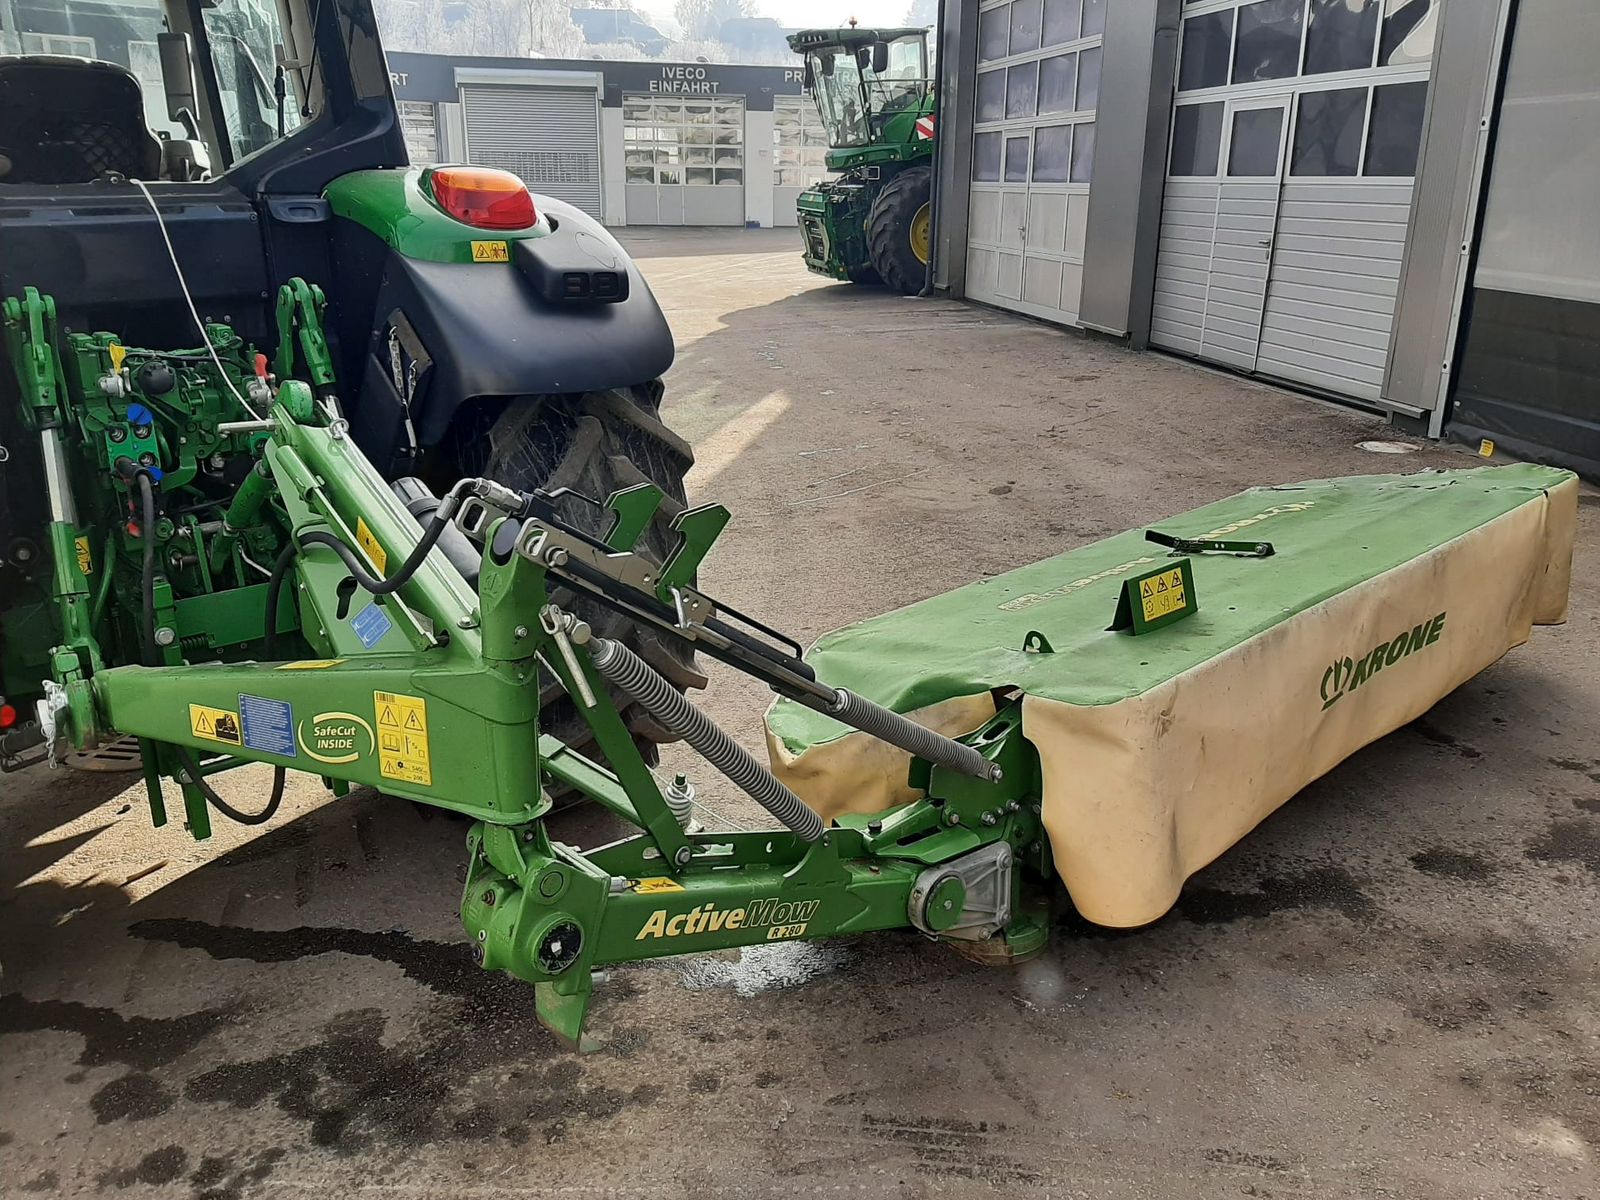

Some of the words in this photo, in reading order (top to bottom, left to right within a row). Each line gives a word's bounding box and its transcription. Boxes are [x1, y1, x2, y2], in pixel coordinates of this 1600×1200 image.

[662, 66, 706, 80] IVECO
[649, 80, 719, 94] EINFAHRT
[1348, 611, 1447, 692] KRONE
[313, 726, 357, 737] SafeCut
[317, 739, 353, 749] INSIDE
[635, 897, 820, 940] ActiveMow
[771, 927, 780, 938] R
[781, 925, 802, 938] 280
